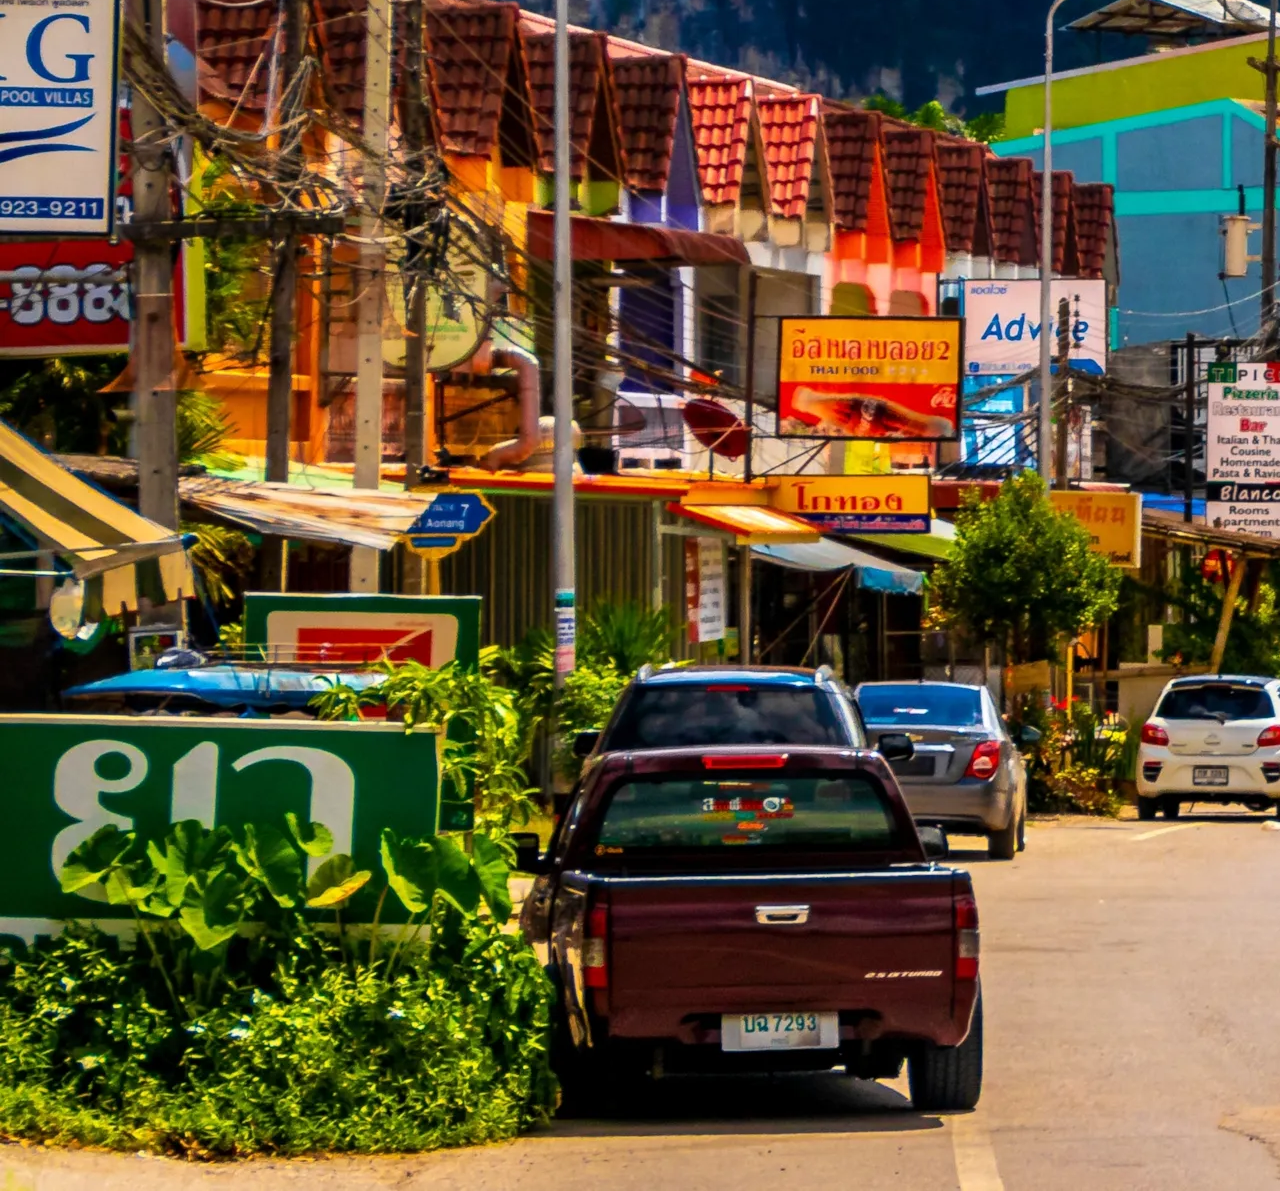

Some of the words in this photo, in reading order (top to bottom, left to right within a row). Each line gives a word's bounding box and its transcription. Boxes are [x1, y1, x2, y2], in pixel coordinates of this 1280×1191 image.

[0, 90, 39, 104] POOL
[44, 91, 91, 105] VILLAS
[980, 313, 1089, 342] Adve
[810, 365, 839, 375] THAI
[843, 365, 879, 375] FOOD
[1222, 386, 1280, 401] Pizzeria
[1240, 418, 1268, 433] Bar
[1217, 435, 1249, 445] Italian
[1251, 435, 1260, 445] &
[1230, 447, 1272, 457] Cousine
[1220, 457, 1280, 467] Homemade
[1212, 469, 1240, 478] Pasta
[1243, 469, 1251, 478] &
[791, 481, 903, 511] โกทอง
[460, 503, 470, 518] 7
[1228, 506, 1270, 516] Rooms
[773, 1014, 817, 1032] 7293
